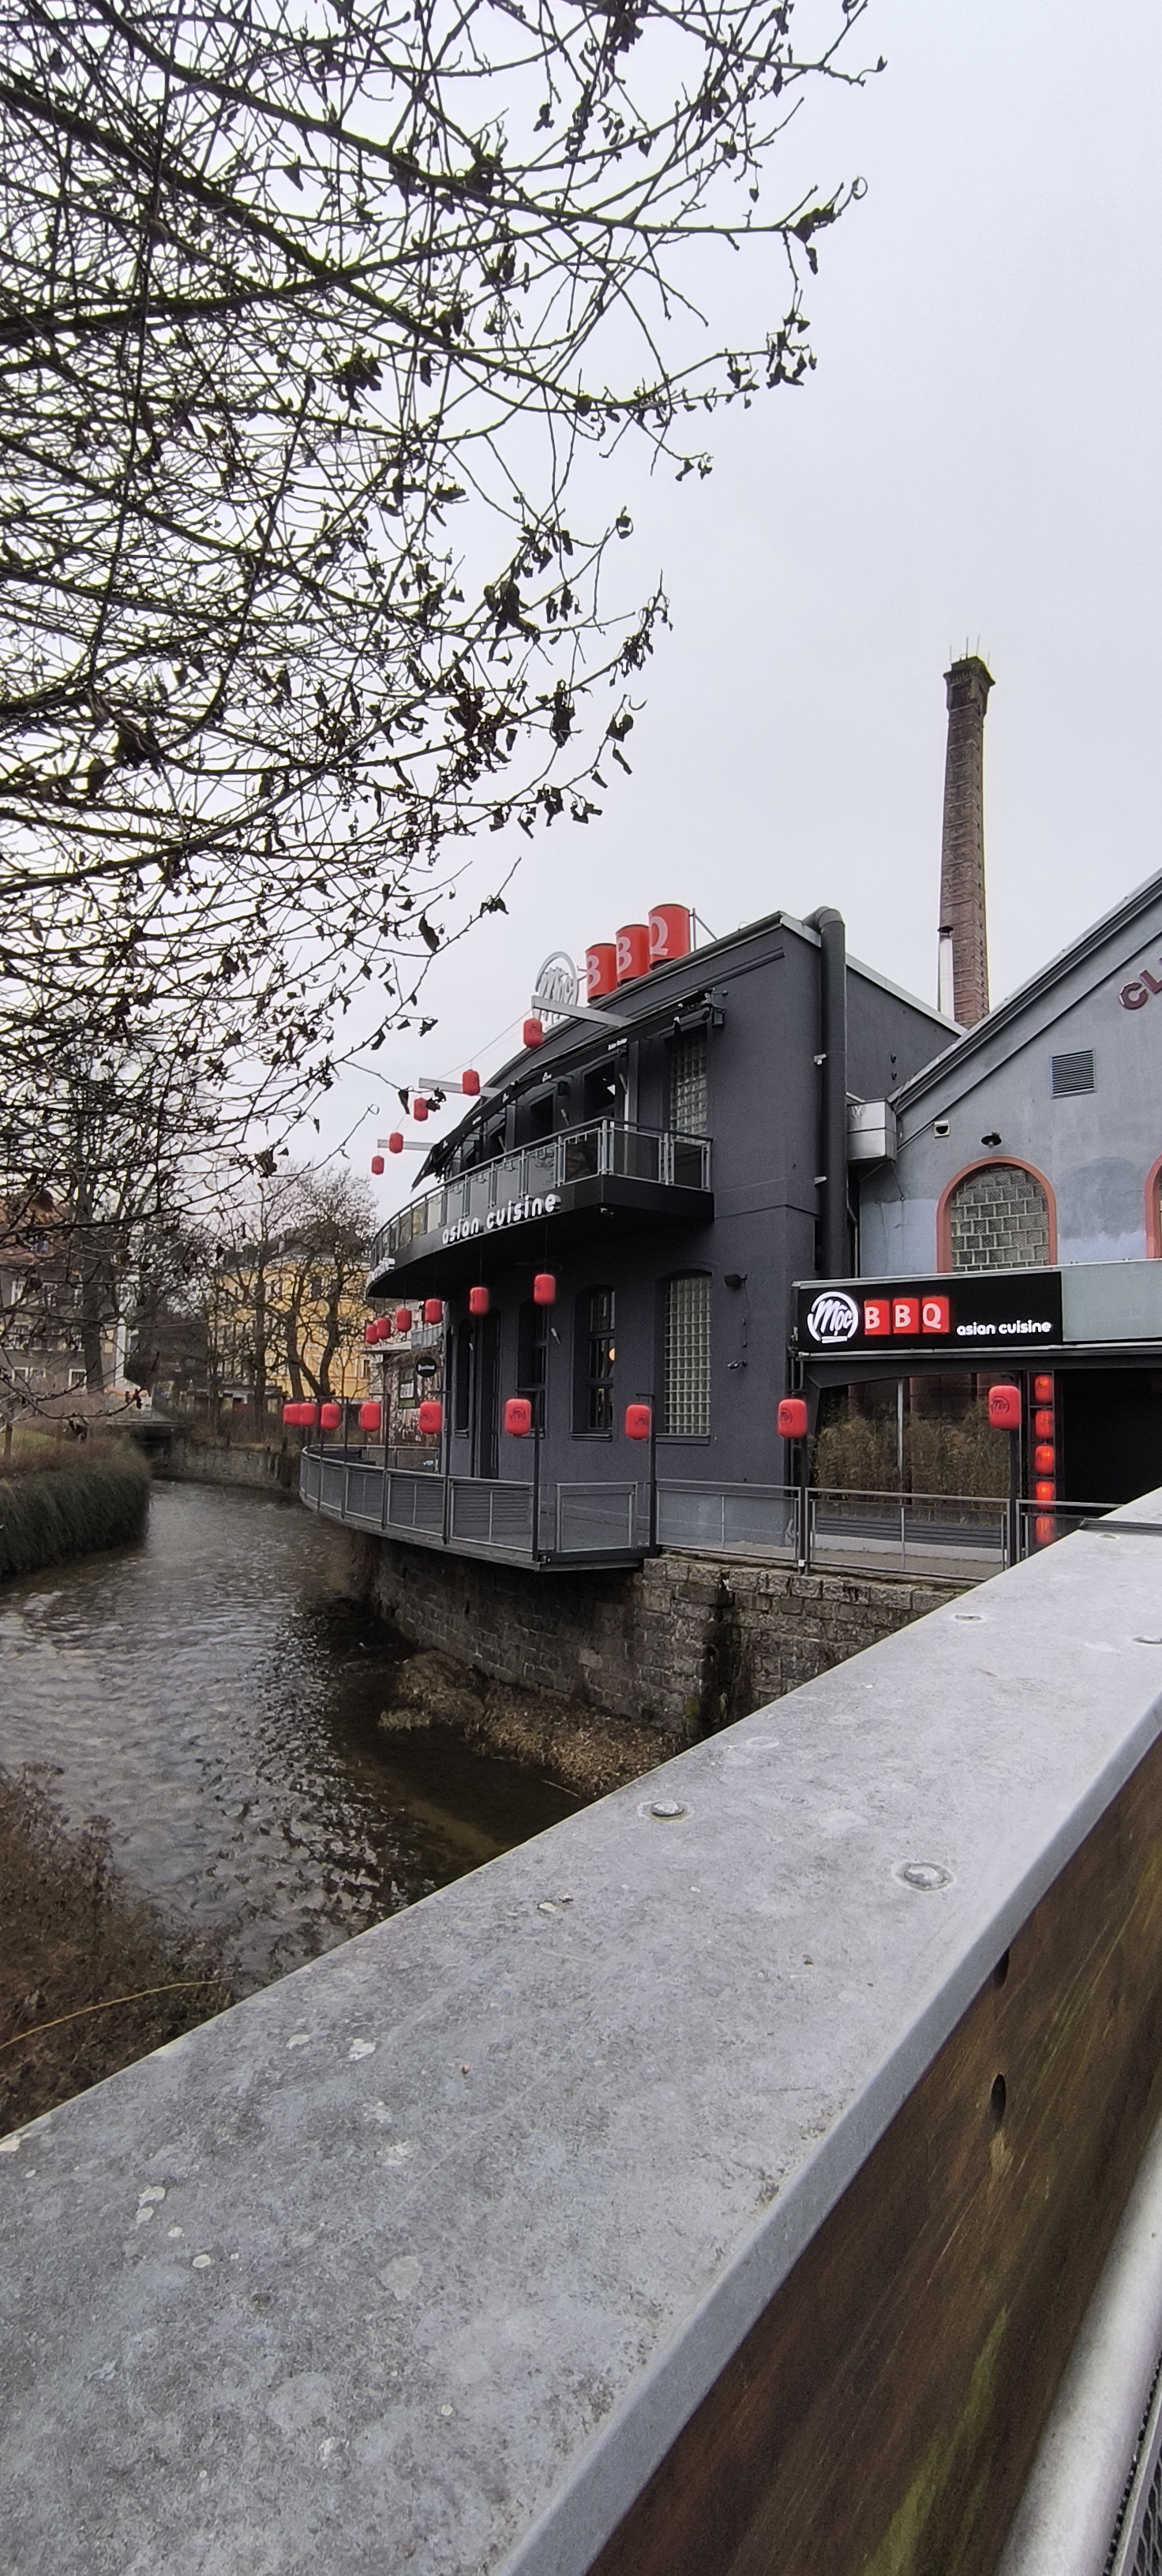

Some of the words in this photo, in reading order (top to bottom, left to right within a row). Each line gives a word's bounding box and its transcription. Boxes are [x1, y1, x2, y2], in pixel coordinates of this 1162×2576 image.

[1119, 957, 1162, 1010] CL
[442, 1218, 484, 1245] asian
[486, 1193, 561, 1230] cuisine
[865, 1303, 942, 1329] BBQ
[957, 1321, 996, 1335] asian
[999, 1320, 1051, 1334] cuisine
